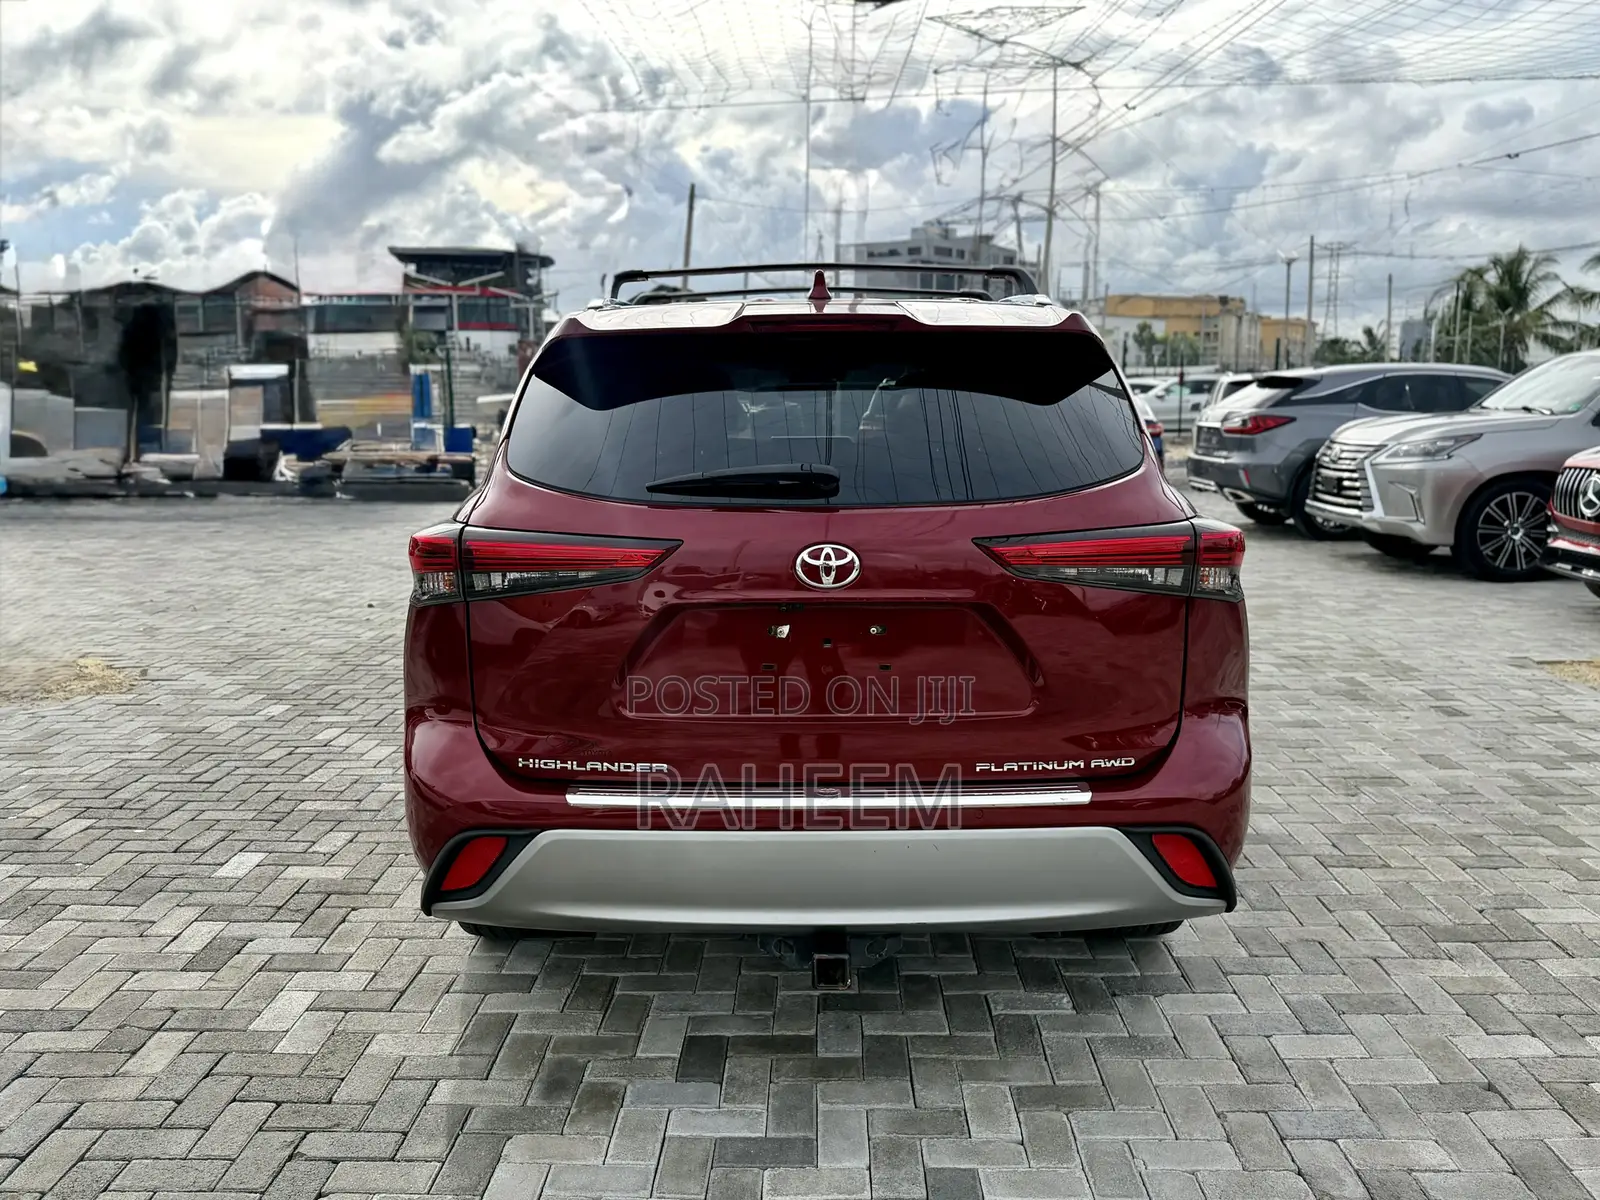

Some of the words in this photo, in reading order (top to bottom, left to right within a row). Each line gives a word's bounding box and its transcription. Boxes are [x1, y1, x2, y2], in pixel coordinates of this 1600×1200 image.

[518, 758, 668, 773] HIGHLANDER
[975, 760, 1085, 772] PLATINUM
[1090, 757, 1136, 768] AWD
